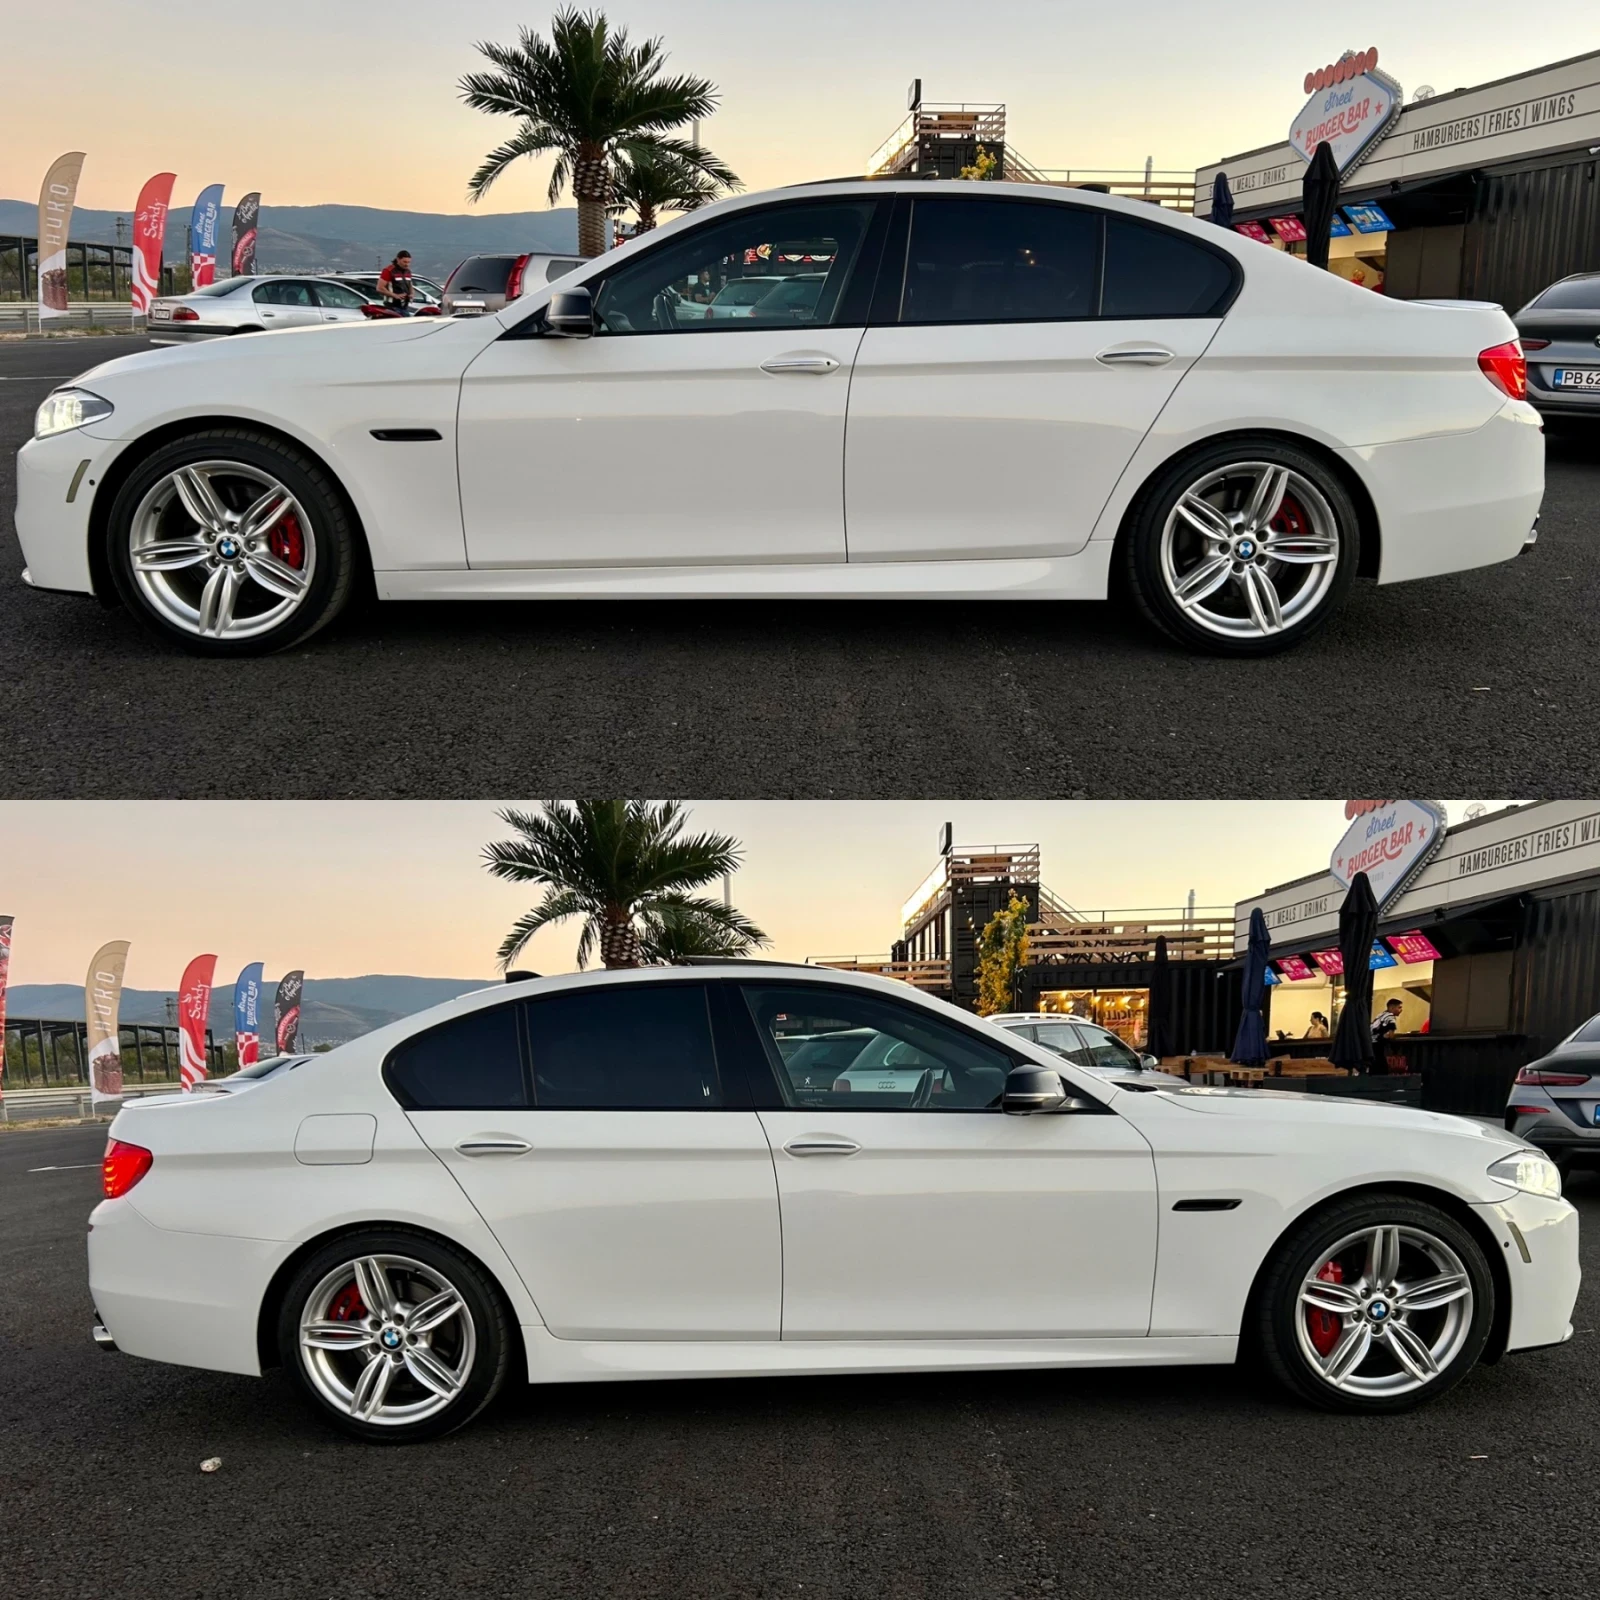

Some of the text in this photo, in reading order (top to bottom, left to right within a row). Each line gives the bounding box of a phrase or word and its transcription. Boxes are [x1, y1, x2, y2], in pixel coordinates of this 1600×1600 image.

[1324, 87, 1354, 115] Street
[1413, 94, 1575, 150] HAMBURGERS FRIES WINGS
[1305, 97, 1370, 152] BURGER BAR
[1236, 167, 1286, 191] MEALS DRINKS
[46, 184, 69, 246] HUKO
[202, 202, 216, 248] BURGER BAR
[1564, 371, 1583, 384] PB
[1365, 810, 1396, 842] Street
[1346, 821, 1413, 879] BURGER BAR
[1459, 839, 1528, 875] HAMBURGERS
[1537, 826, 1570, 854] FRIES
[1277, 907, 1296, 924] MEALS
[1304, 898, 1328, 917] DRINKS
[94, 971, 115, 1032] HUKO
[246, 980, 257, 1026] BURGER BAR
